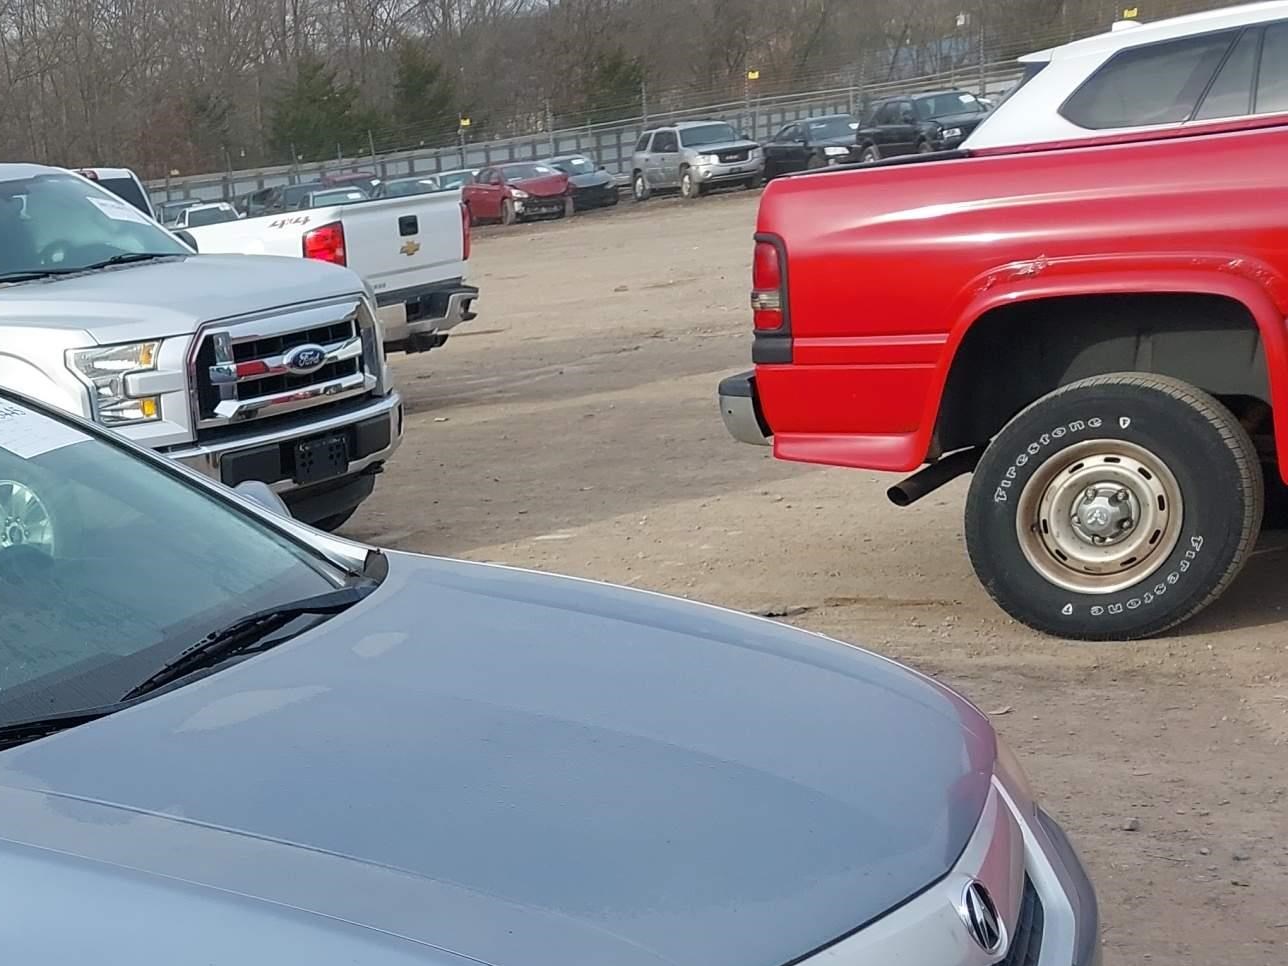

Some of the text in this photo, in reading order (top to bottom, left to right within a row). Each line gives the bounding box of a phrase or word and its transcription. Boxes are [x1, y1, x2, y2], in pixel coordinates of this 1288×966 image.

[298, 351, 320, 367] Ford
[994, 417, 1103, 503] Firestone
[1090, 535, 1204, 616] Firestone
